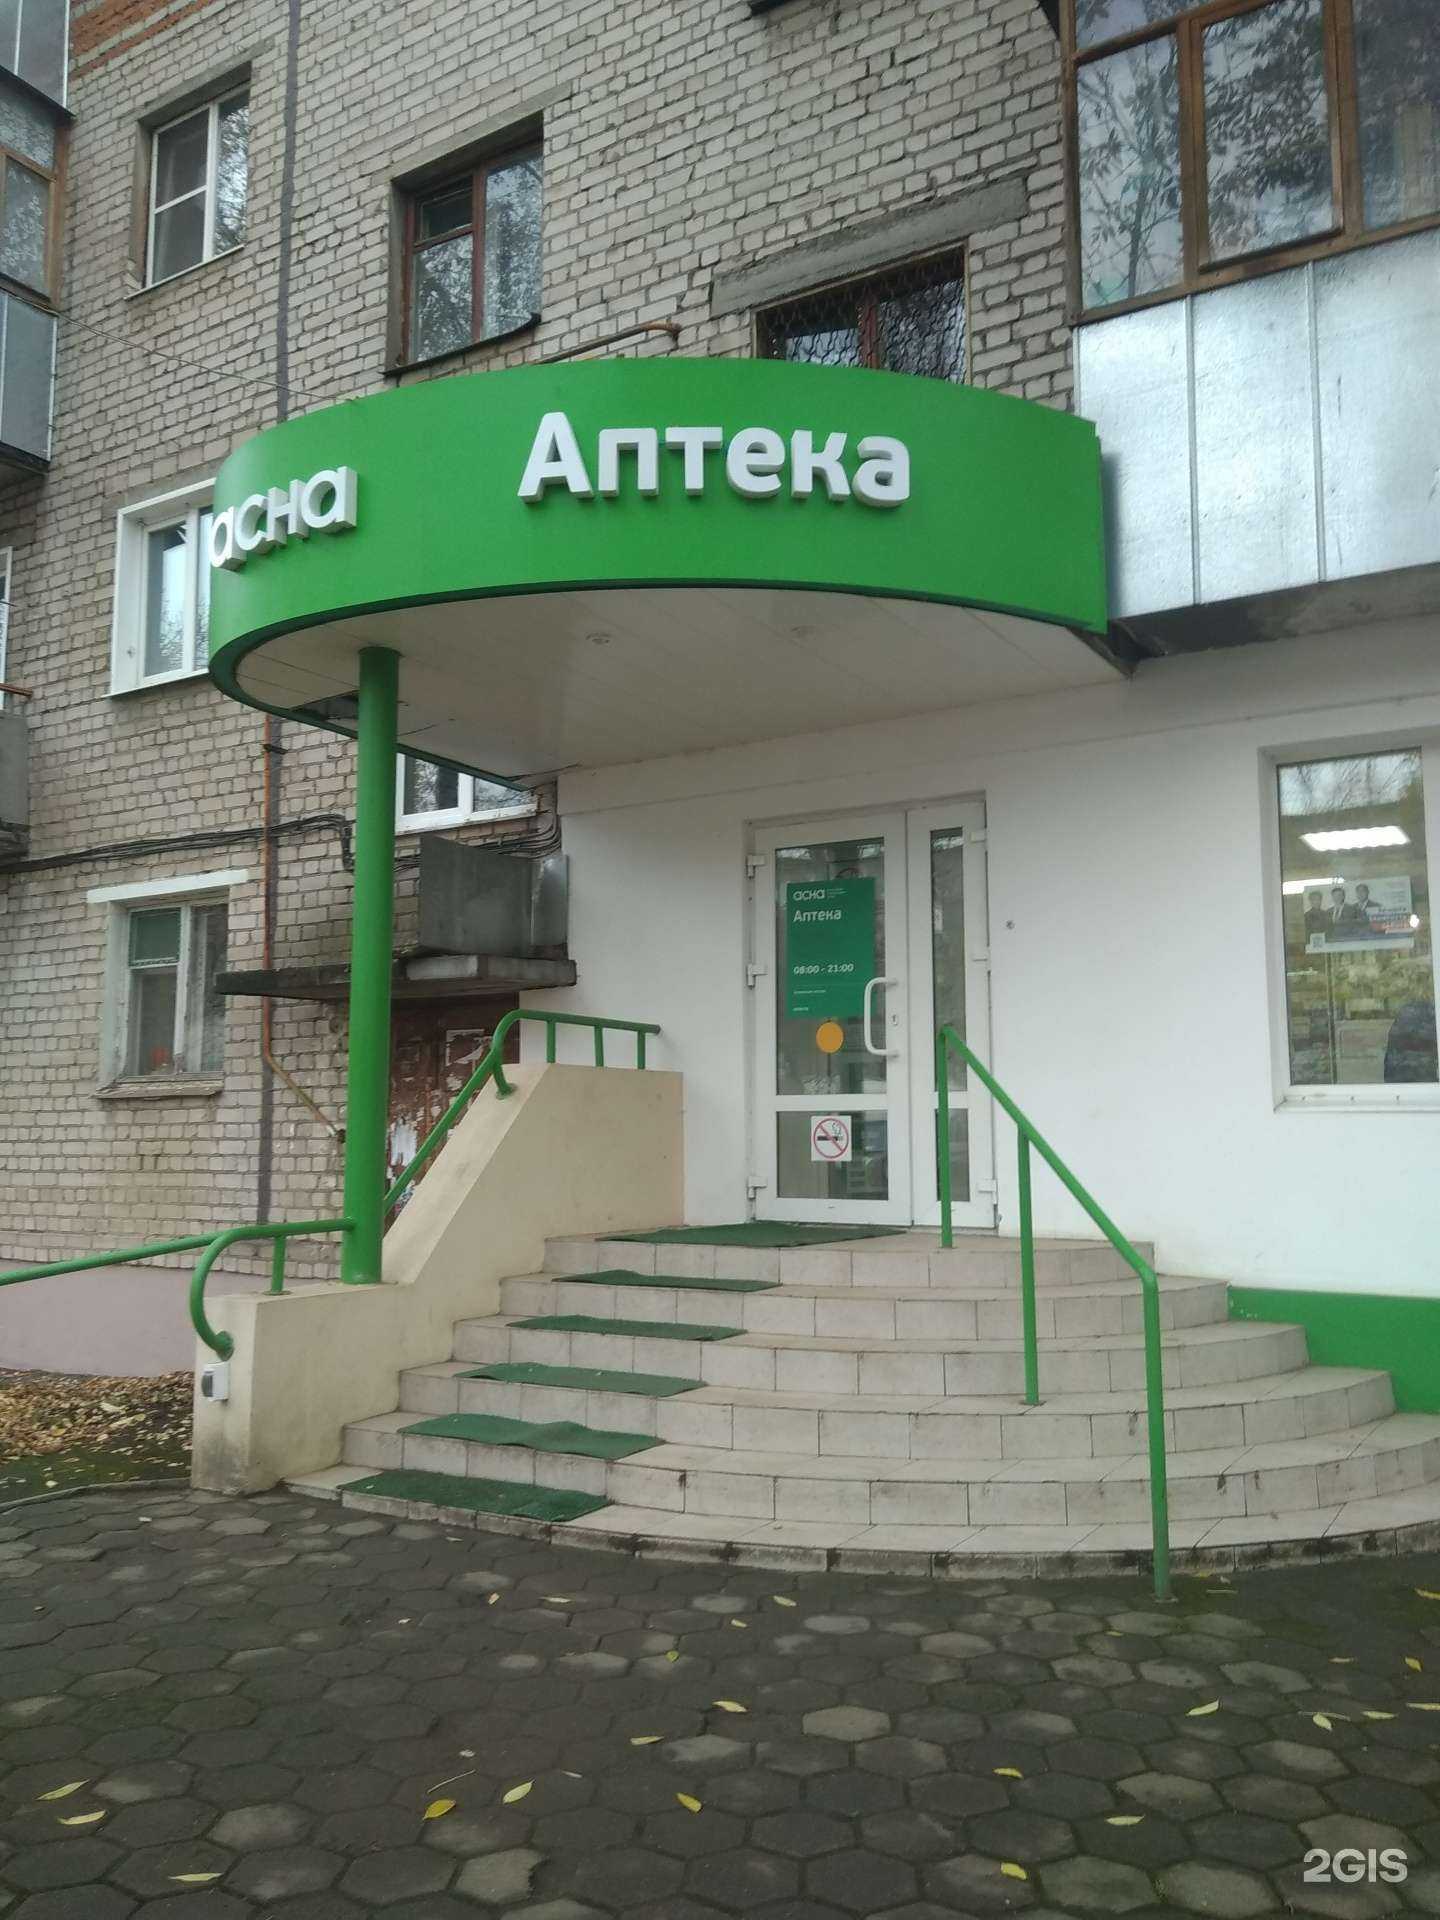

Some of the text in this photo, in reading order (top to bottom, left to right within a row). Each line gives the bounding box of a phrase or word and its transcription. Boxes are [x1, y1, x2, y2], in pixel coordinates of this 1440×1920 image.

[517, 411, 910, 508] Аптека
[208, 466, 357, 572] асна
[793, 889, 825, 901] асна
[793, 909, 842, 922] Аптека
[827, 963, 854, 973] 21:00
